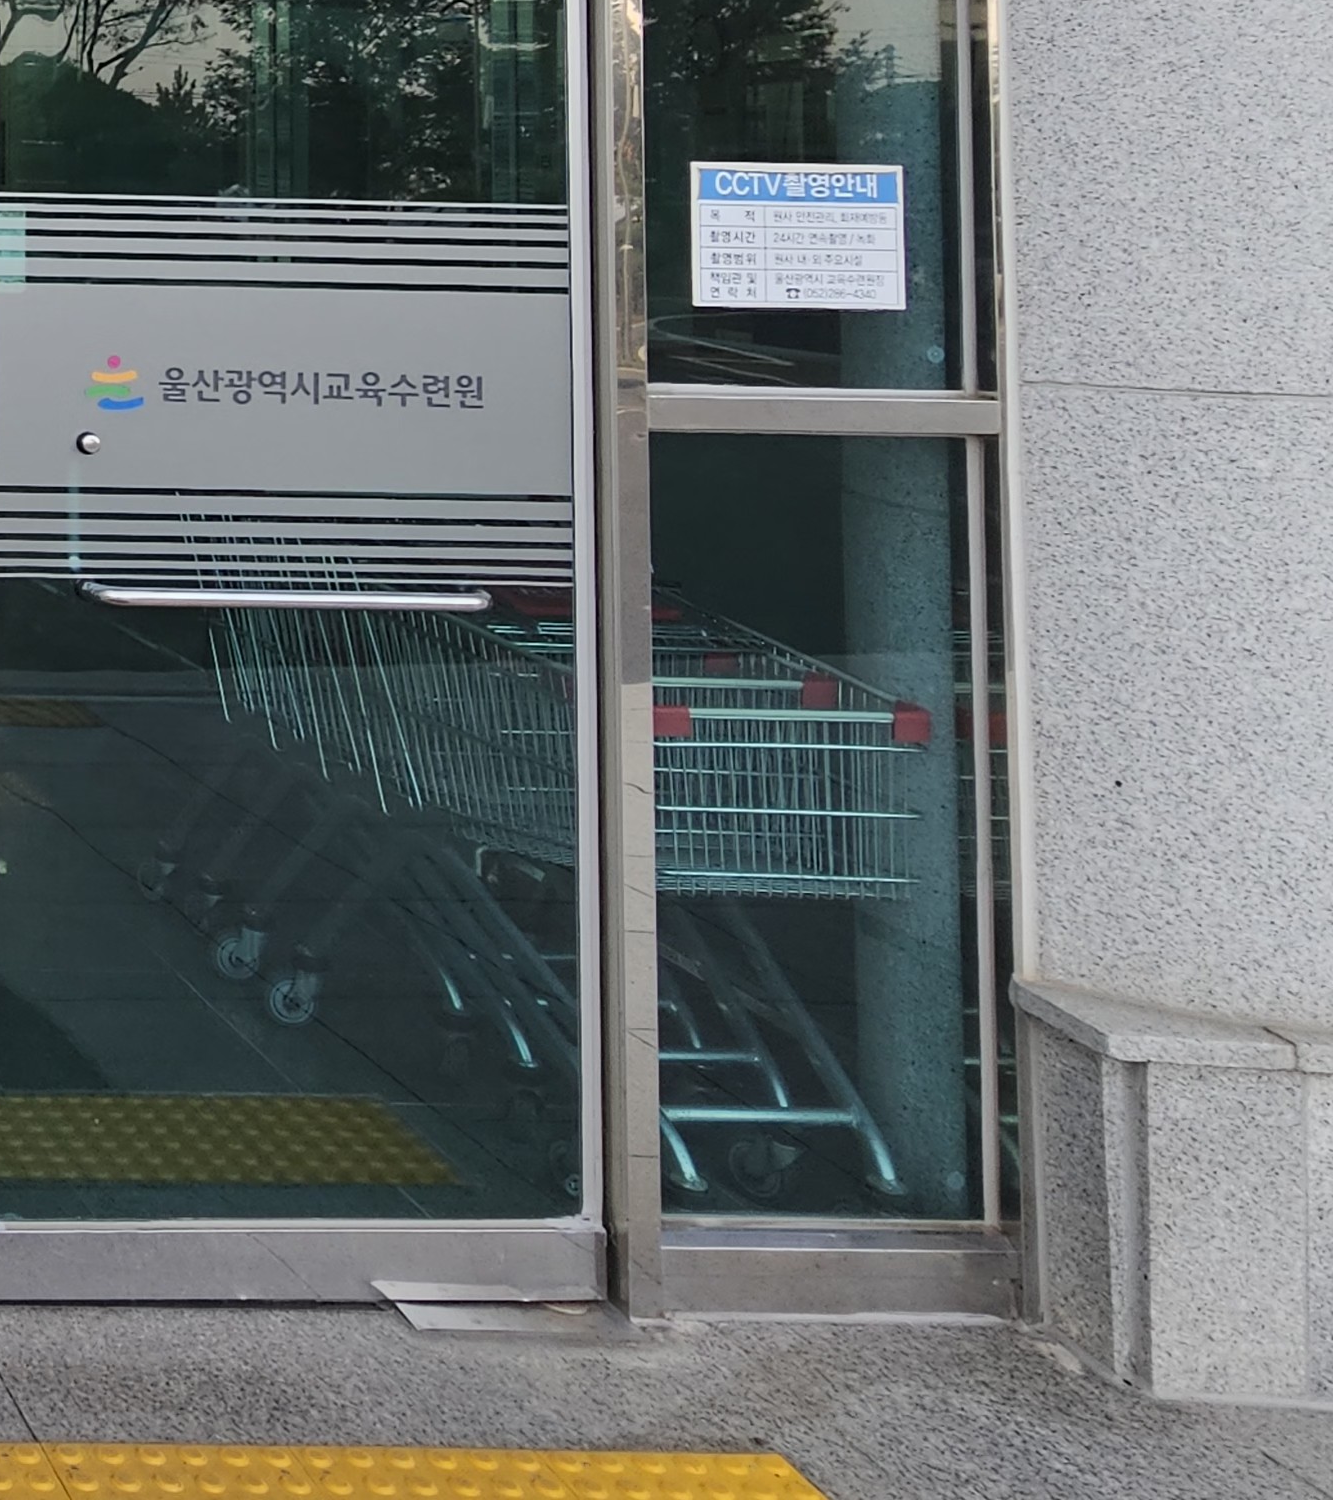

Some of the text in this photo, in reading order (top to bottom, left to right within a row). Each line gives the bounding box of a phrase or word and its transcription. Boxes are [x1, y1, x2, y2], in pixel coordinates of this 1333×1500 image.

[715, 171, 878, 199] CCTV촬영안내
[710, 231, 756, 244] 촬영시간
[773, 232, 804, 245] 24시간
[158, 367, 484, 409] 울산광역시교육수련원
